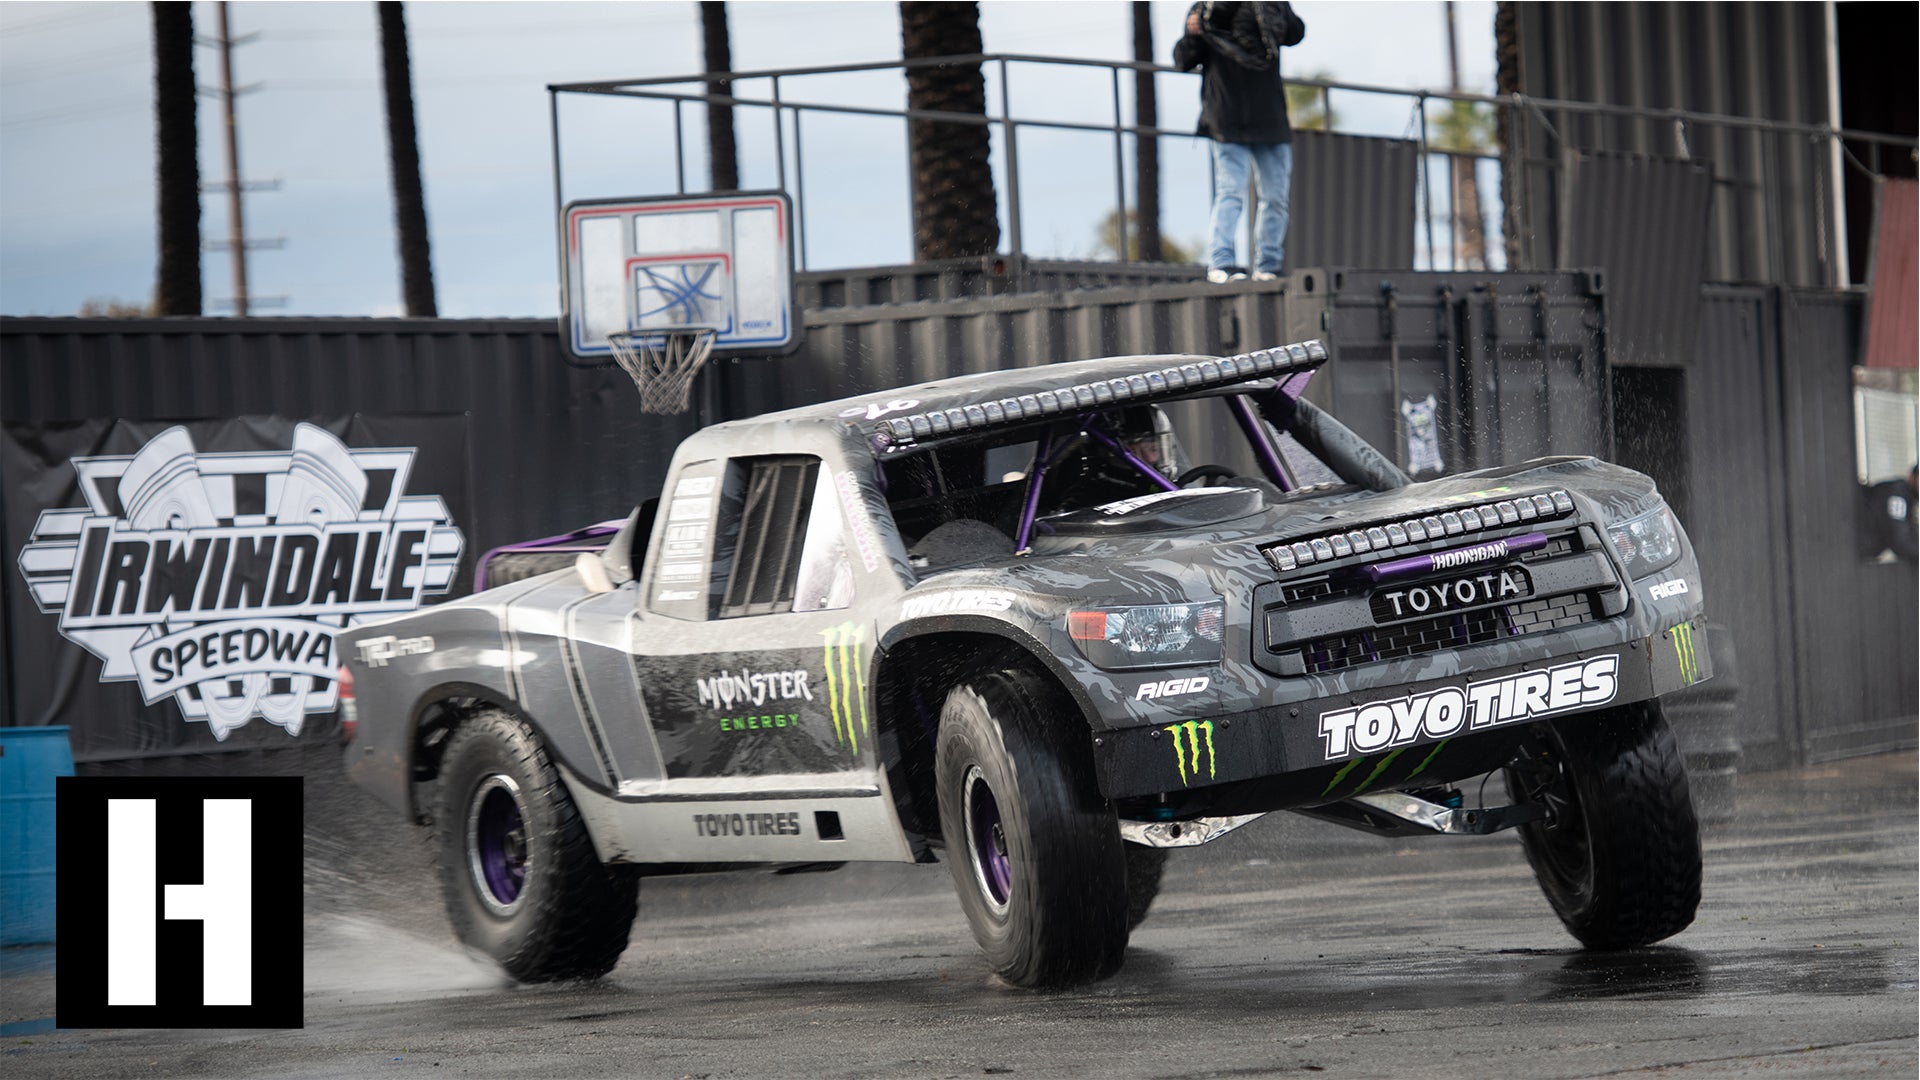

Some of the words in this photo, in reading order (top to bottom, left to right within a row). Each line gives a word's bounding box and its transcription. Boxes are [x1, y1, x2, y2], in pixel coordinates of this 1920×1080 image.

[70, 522, 428, 618] IRWINDALE
[1386, 572, 1519, 615] TOYOTA
[1648, 578, 1689, 601] RIGID
[900, 592, 951, 620] TOYO
[950, 590, 1016, 612] TIRES
[151, 628, 341, 683] SPEEDWA
[1135, 676, 1210, 701] RIGID
[1319, 686, 1467, 760] TOYO
[1466, 654, 1620, 730] TIRES
[720, 713, 799, 732] ENERGY
[693, 813, 744, 837] TOYO
[747, 812, 801, 836] TIRES
